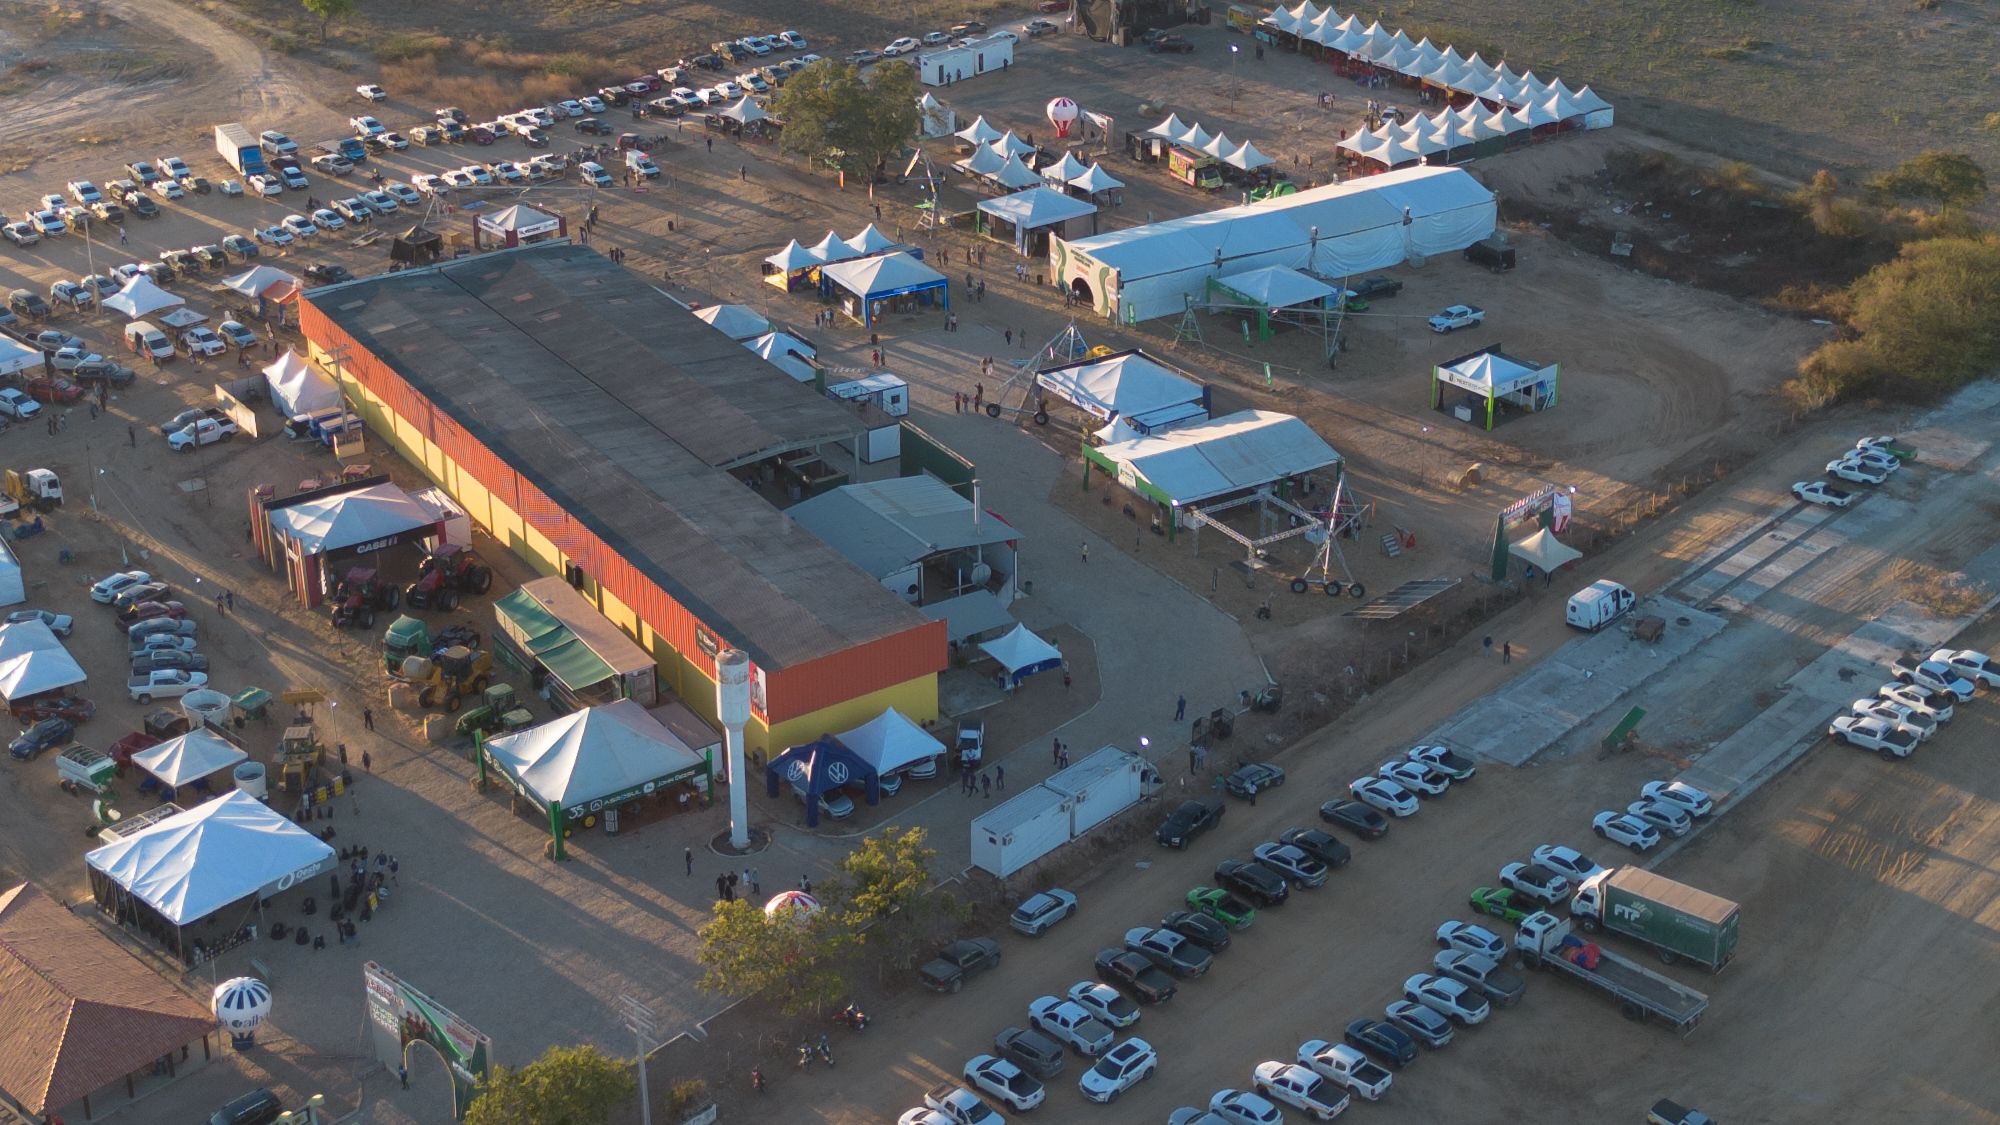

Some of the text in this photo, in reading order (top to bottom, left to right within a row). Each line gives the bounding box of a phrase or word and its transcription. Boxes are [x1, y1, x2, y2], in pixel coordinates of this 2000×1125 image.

[357, 538, 387, 554] CASE
[568, 805, 585, 820] 35
[1614, 903, 1640, 921] FTP
